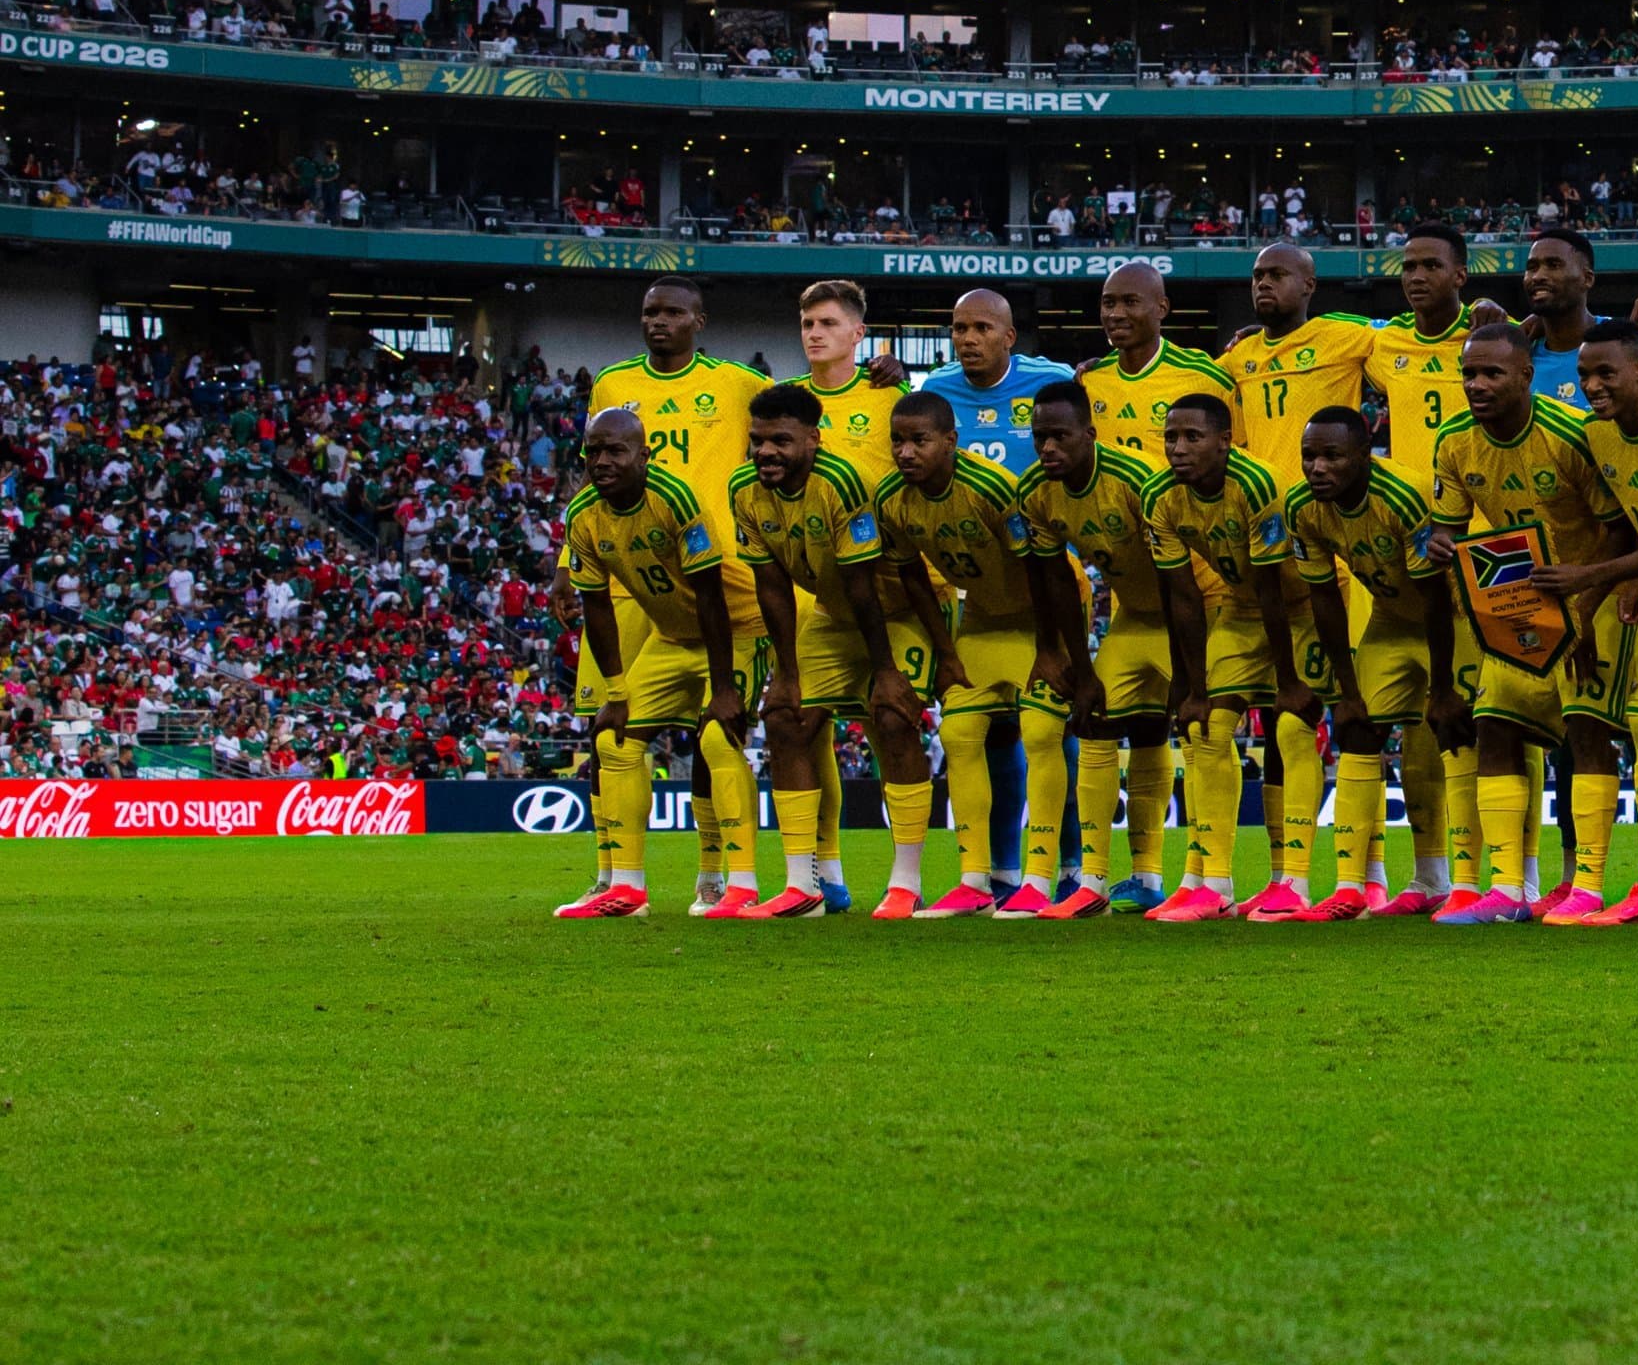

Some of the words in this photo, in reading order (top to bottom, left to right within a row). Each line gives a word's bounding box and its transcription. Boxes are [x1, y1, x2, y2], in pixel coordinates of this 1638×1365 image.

[21, 36, 74, 59] CUP
[79, 42, 169, 69] 2026
[864, 88, 1110, 112] MONTERREY
[108, 221, 232, 249] #FIFAWorldCup
[883, 253, 934, 273] FIFA
[936, 255, 1027, 275] WORLD
[1033, 256, 1081, 276] CUP
[1263, 378, 1288, 419] 17
[1424, 390, 1442, 430] 3
[650, 429, 690, 464] 24
[636, 564, 675, 597] 19
[940, 551, 983, 579] 23
[1487, 588, 1511, 599] SOUTH
[1491, 602, 1515, 613] SOUTH
[903, 646, 925, 681] 9
[1305, 641, 1323, 679] 8
[1457, 664, 1477, 704] 5
[113, 800, 179, 828] zero
[184, 800, 262, 834] sugar
[276, 781, 417, 837] Coca-Cola
